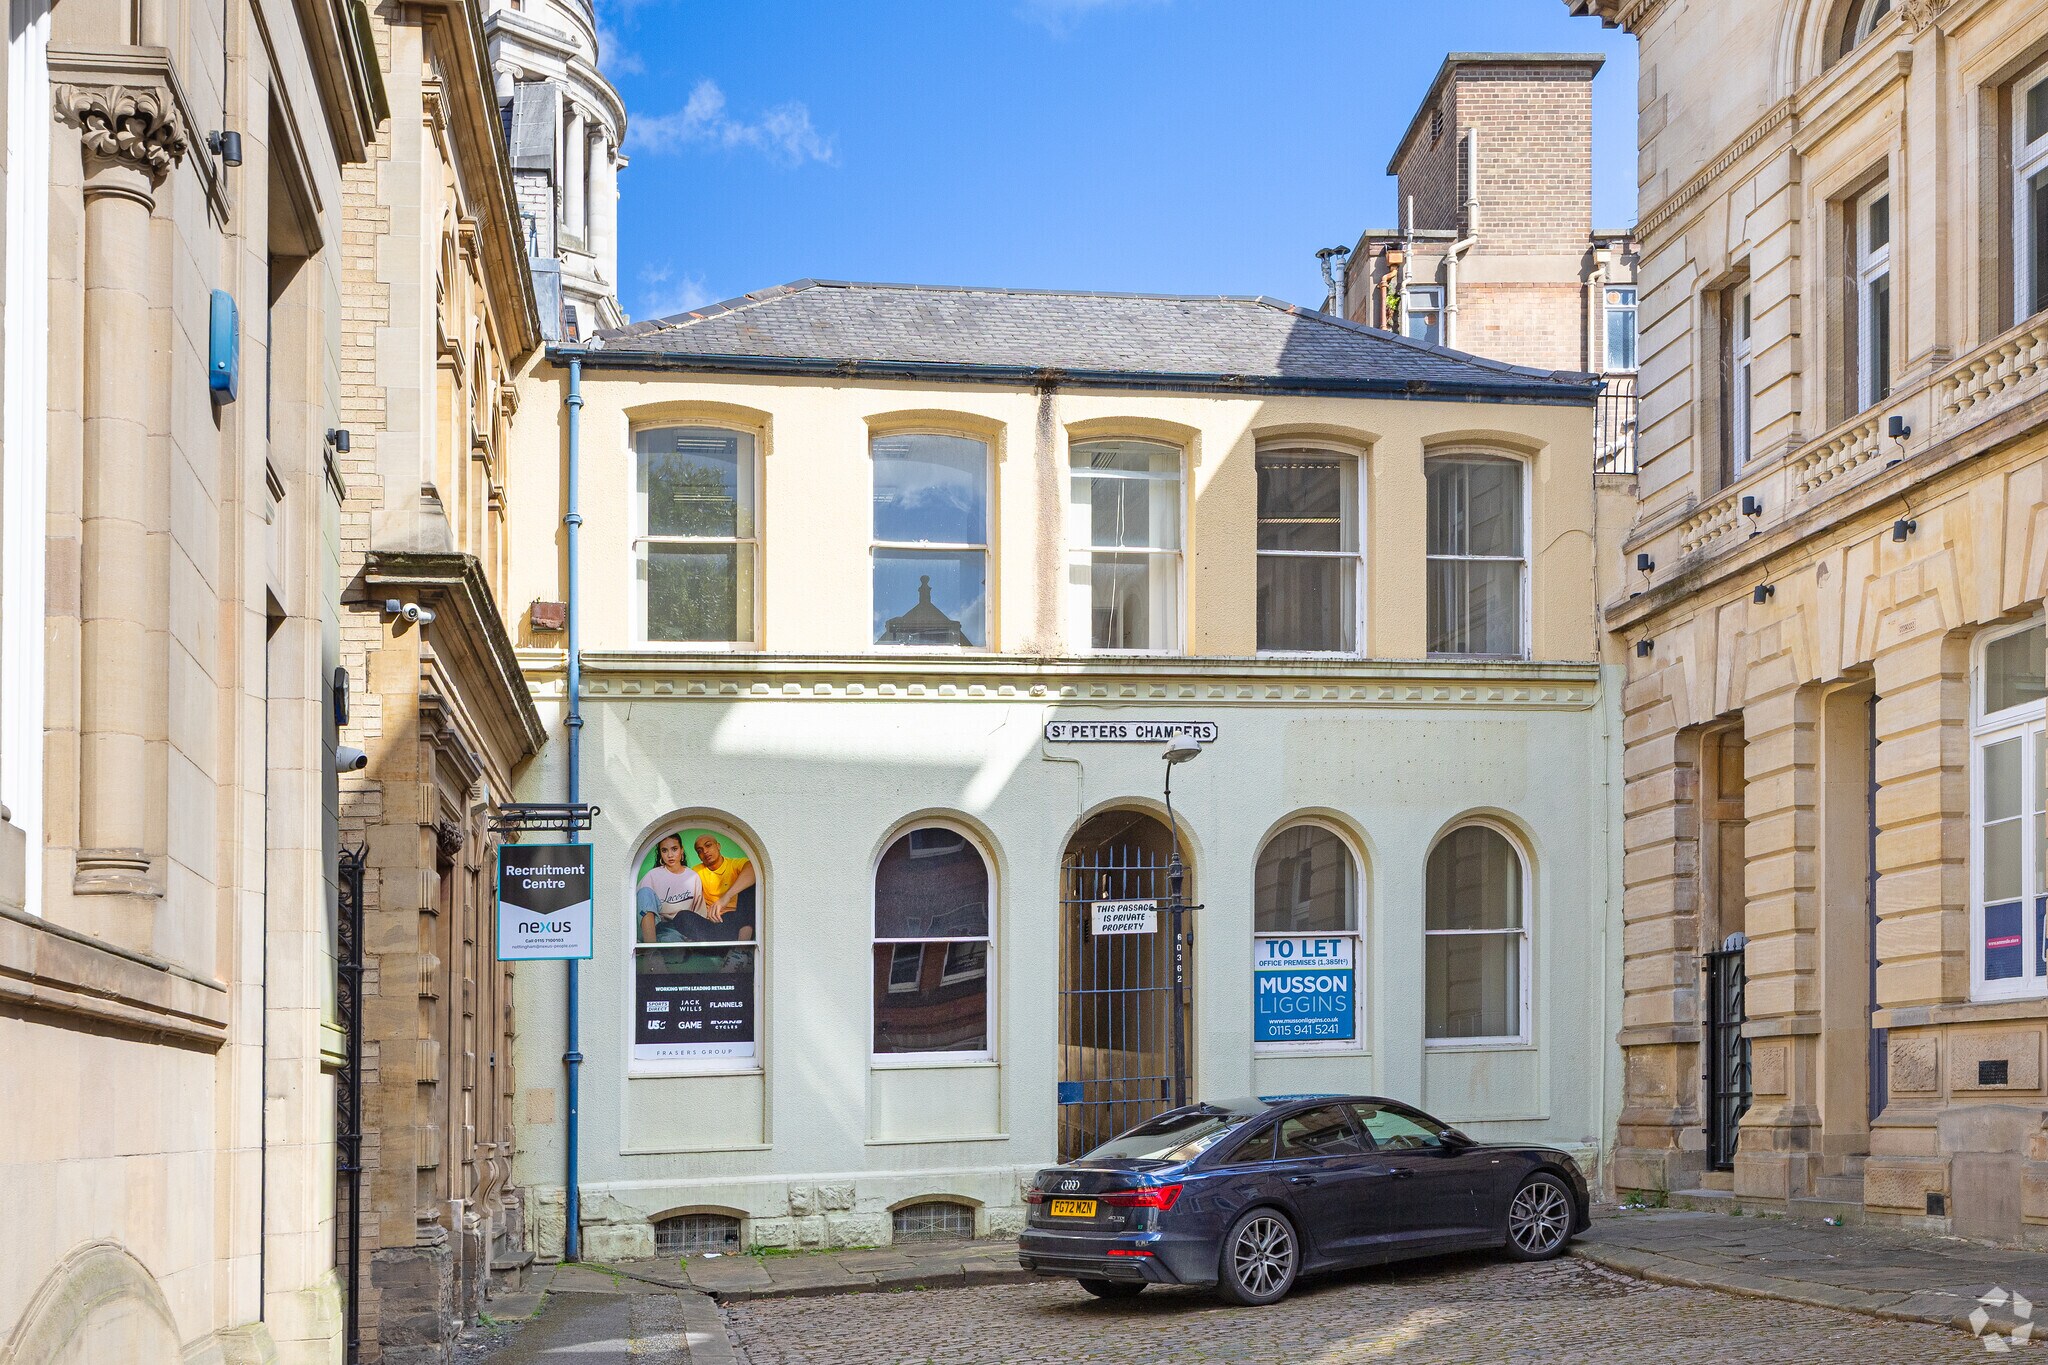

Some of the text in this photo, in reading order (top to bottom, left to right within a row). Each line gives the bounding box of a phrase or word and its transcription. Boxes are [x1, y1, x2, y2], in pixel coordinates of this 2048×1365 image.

[1072, 725, 1127, 738] PETERS
[506, 864, 585, 876] Recruitment
[522, 879, 566, 889] Centre
[1097, 905, 1116, 913] THIS
[1113, 913, 1145, 921] PRIVATE
[518, 921, 571, 933] nexus
[1102, 923, 1144, 931] PROPERTY
[1265, 939, 1342, 958] TO LET
[1260, 975, 1347, 994] MUSSON
[1260, 995, 1347, 1014] LIGGINS
[648, 1020, 666, 1030] USC
[678, 1021, 702, 1029] GAME
[1268, 1024, 1339, 1036] 0115 941 5241
[1053, 1200, 1093, 1214] FG72 MZN
